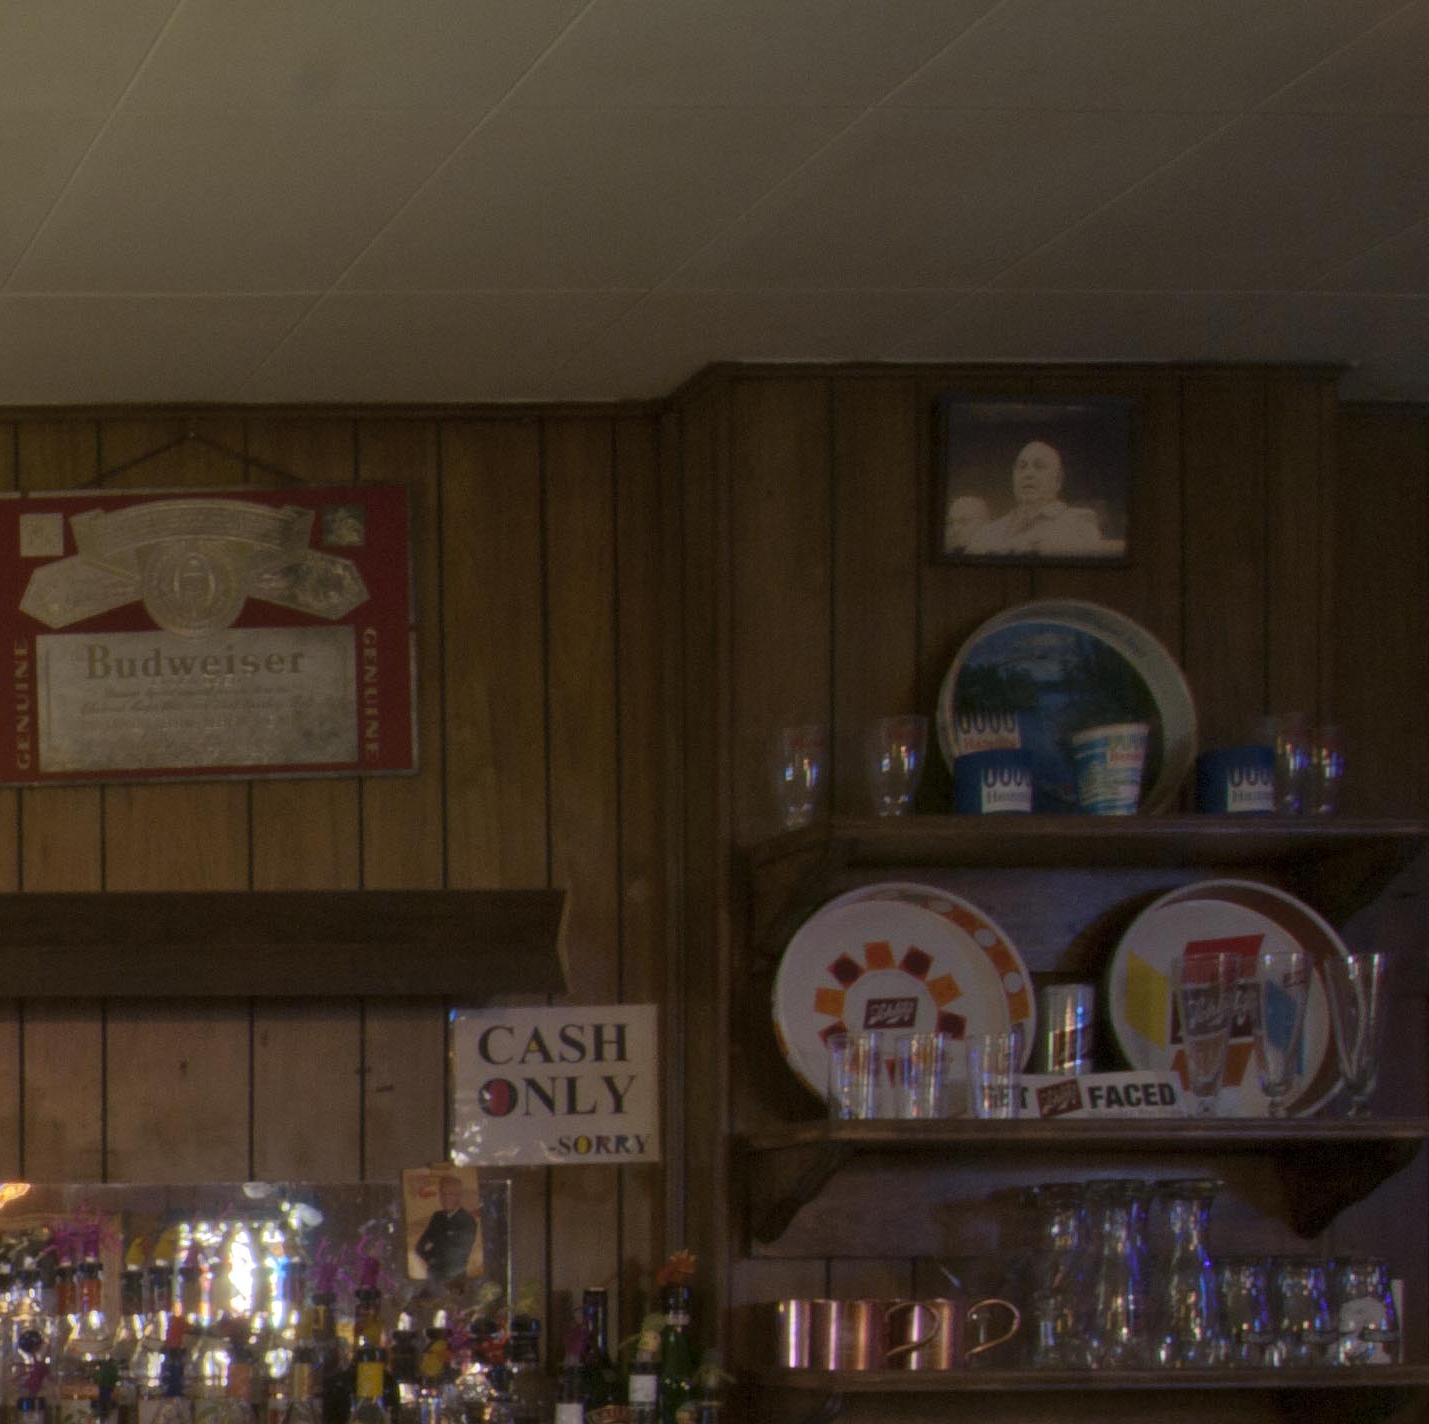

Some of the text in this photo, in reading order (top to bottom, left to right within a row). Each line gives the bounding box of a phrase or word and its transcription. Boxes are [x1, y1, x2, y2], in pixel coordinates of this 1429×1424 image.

[84, 643, 305, 681] Budweiser
[13, 638, 32, 771] GENUINE
[362, 626, 381, 762] GENUINE
[478, 1023, 629, 1065] CASH
[478, 1074, 637, 1118] ONLY
[1087, 1082, 1176, 1110] FACED
[548, 1133, 652, 1155] -SORRY
